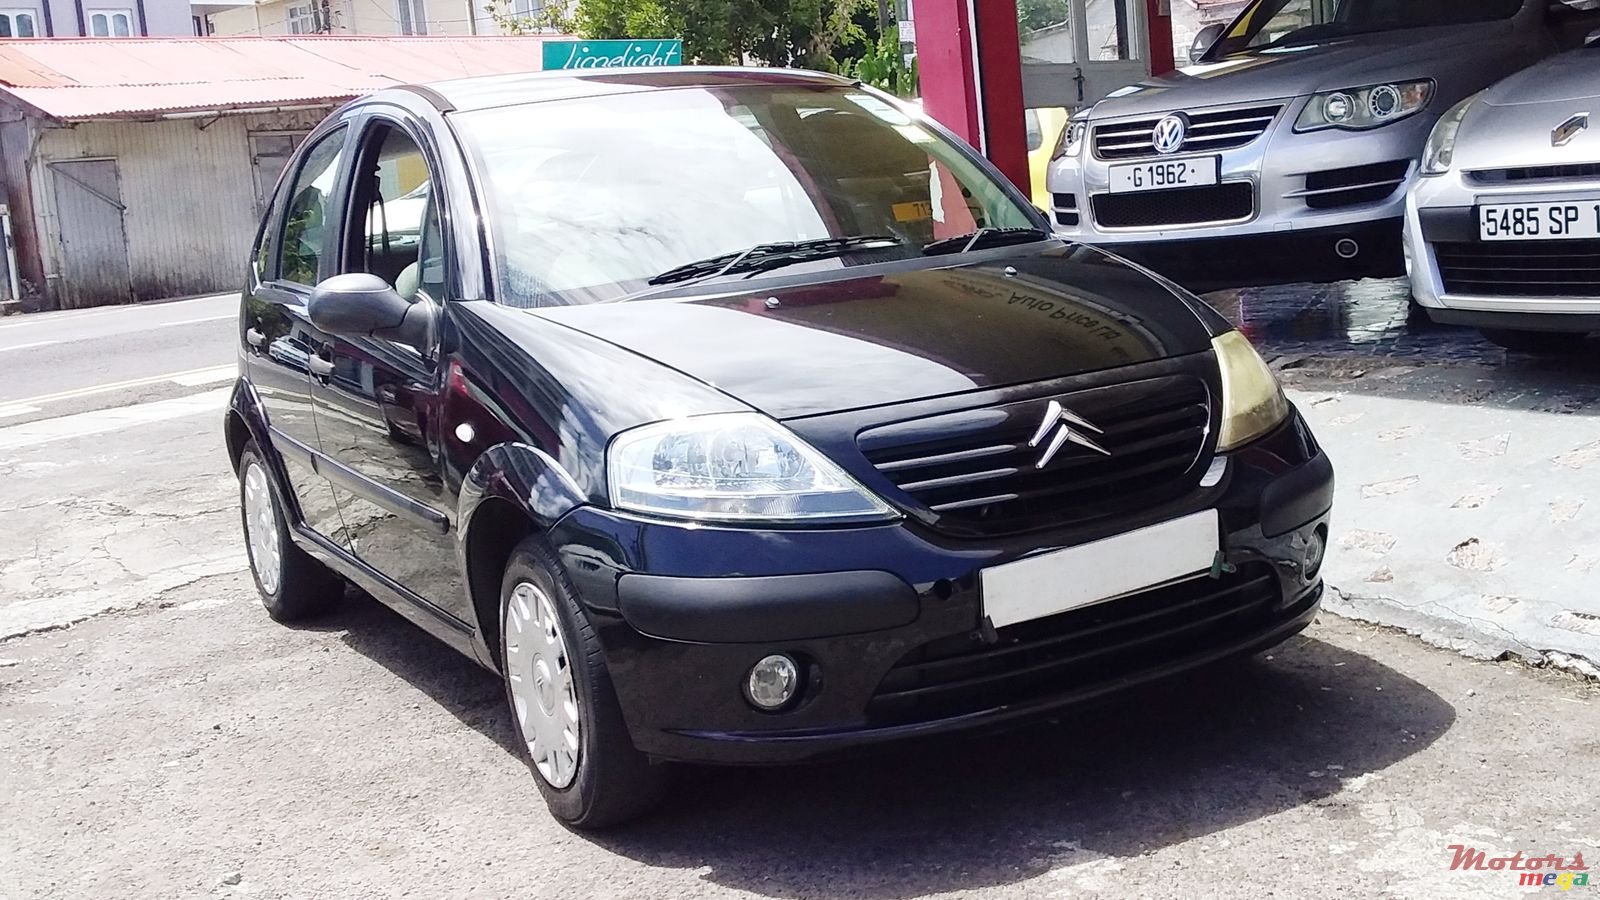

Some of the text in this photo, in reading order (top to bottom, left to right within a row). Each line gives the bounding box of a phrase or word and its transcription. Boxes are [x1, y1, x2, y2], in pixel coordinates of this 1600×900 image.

[1133, 162, 1187, 187] G 1962
[1486, 207, 1540, 236] 5485
[1548, 206, 1579, 235] SP
